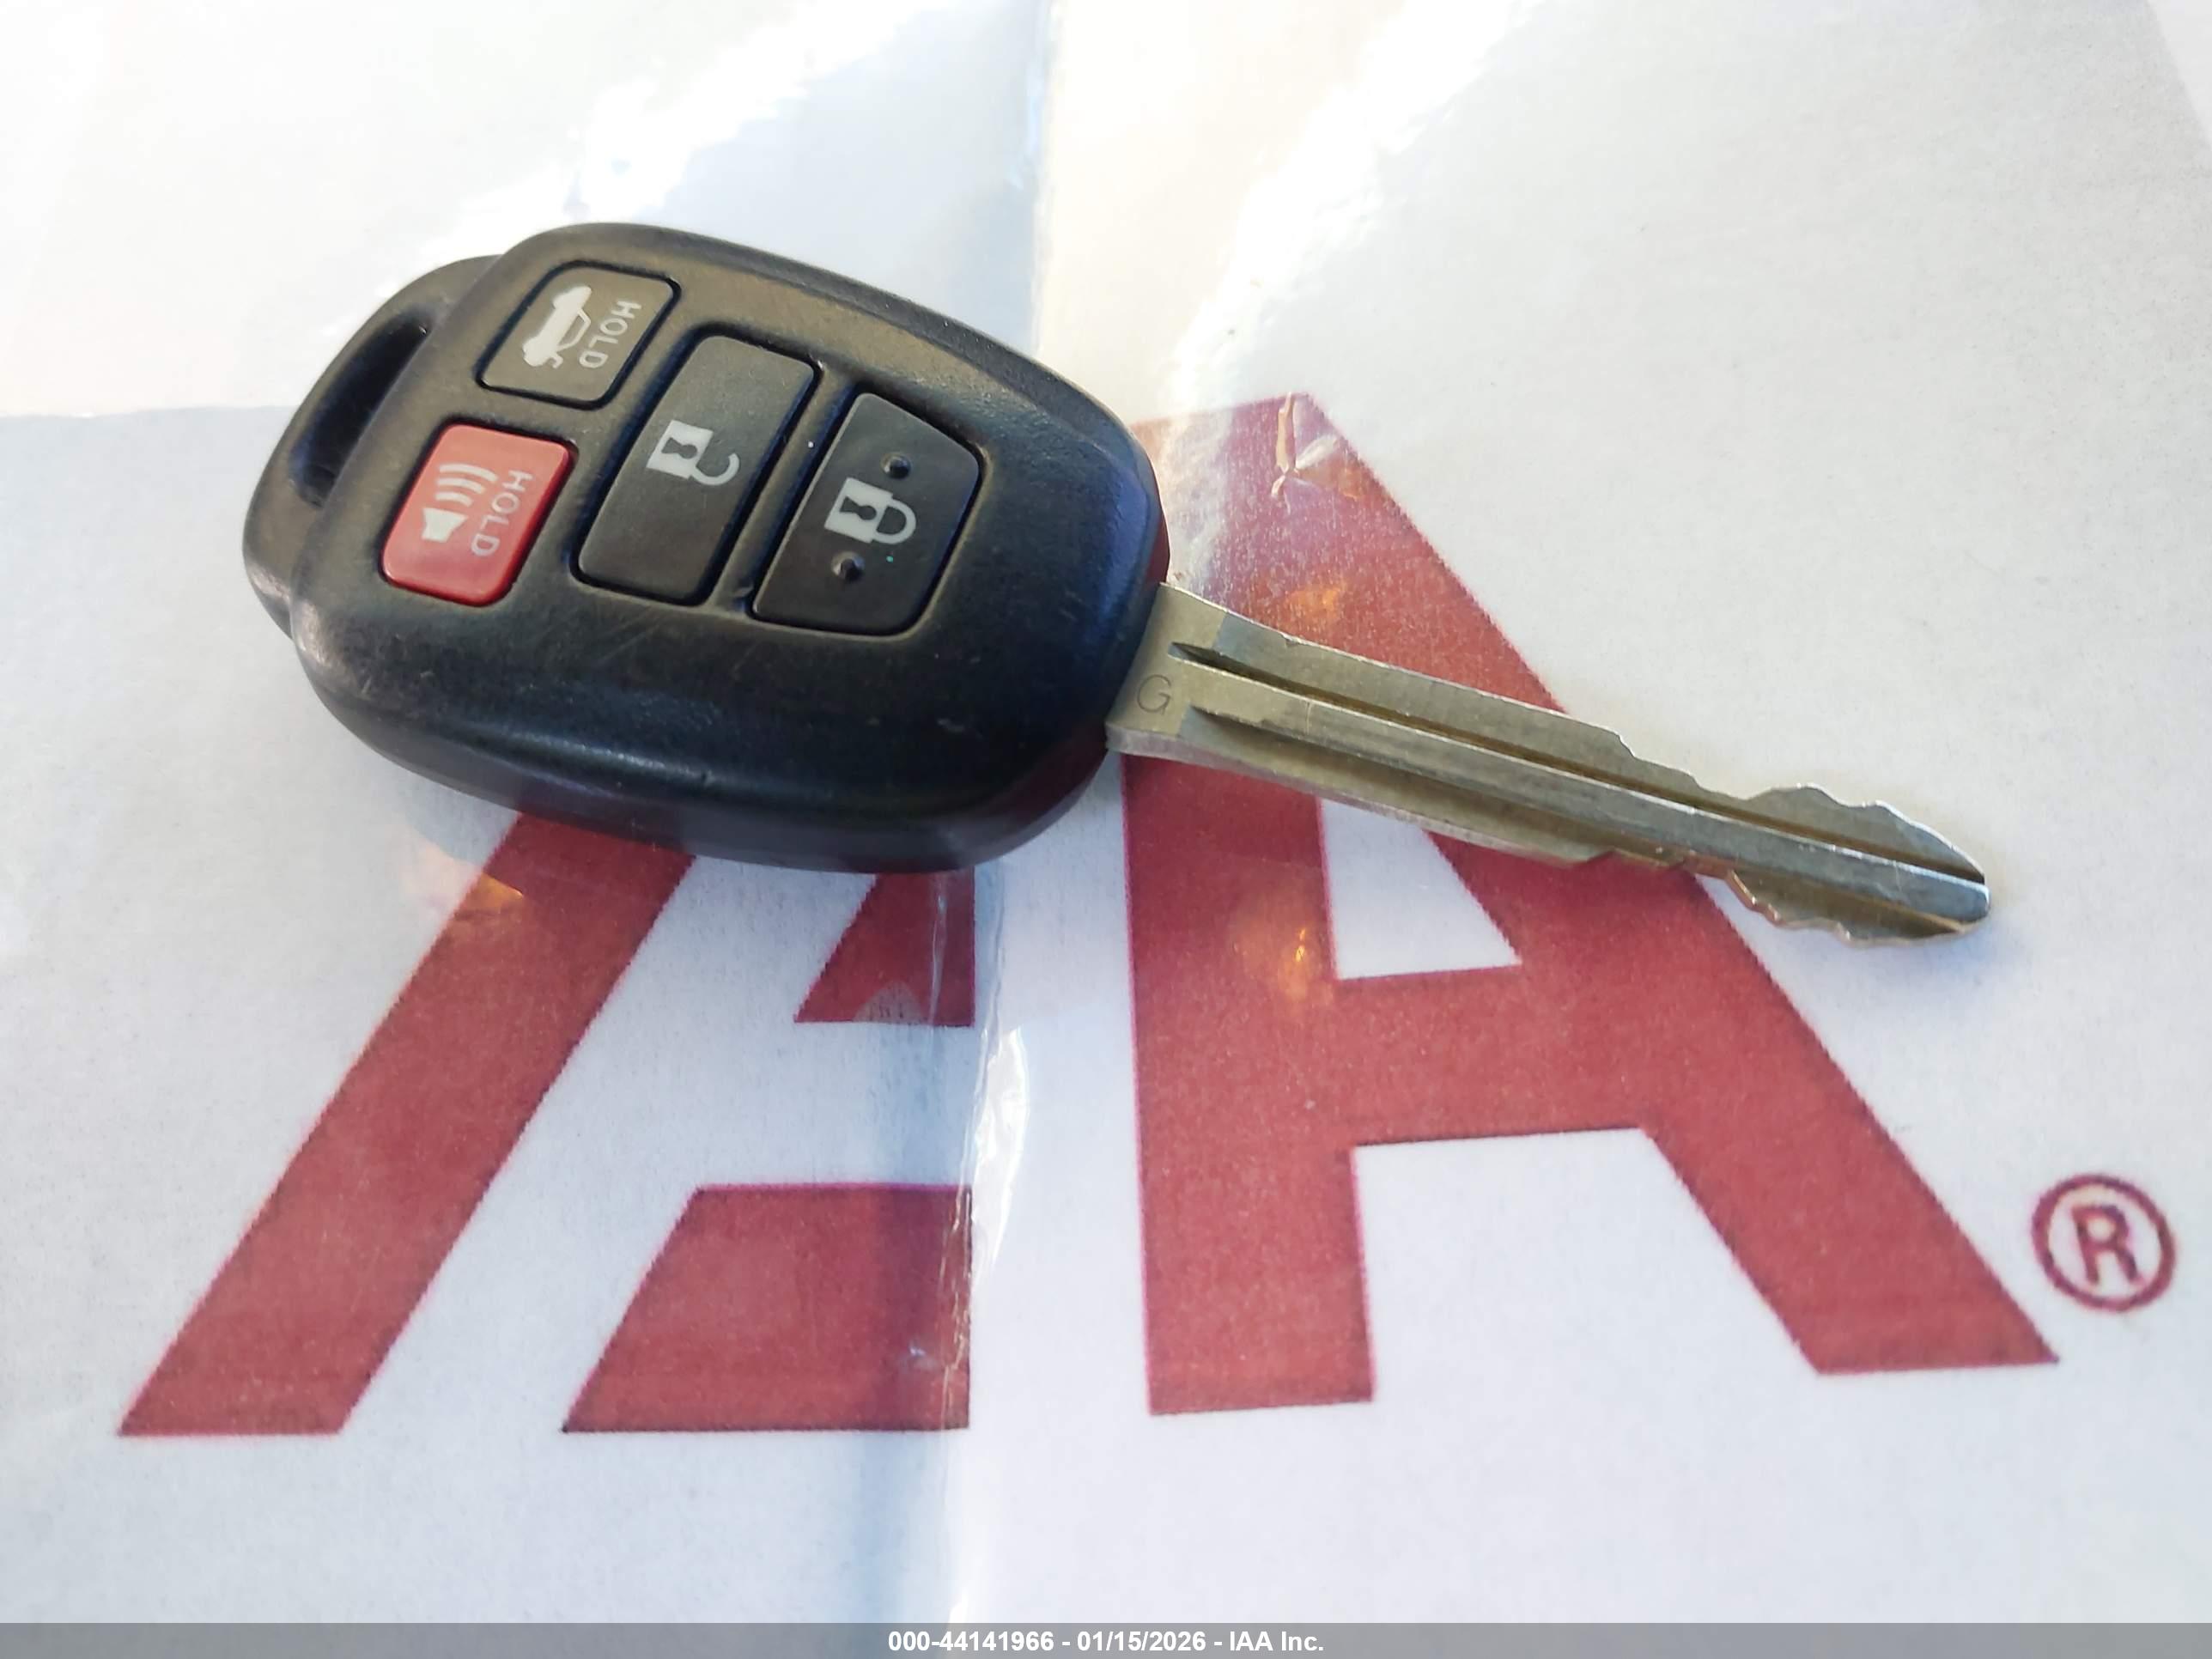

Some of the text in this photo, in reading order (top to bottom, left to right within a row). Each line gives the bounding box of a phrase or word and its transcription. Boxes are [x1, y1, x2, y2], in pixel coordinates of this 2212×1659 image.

[579, 301, 641, 368] HOLD
[471, 470, 534, 556] HOLD
[1136, 673, 1173, 715] G
